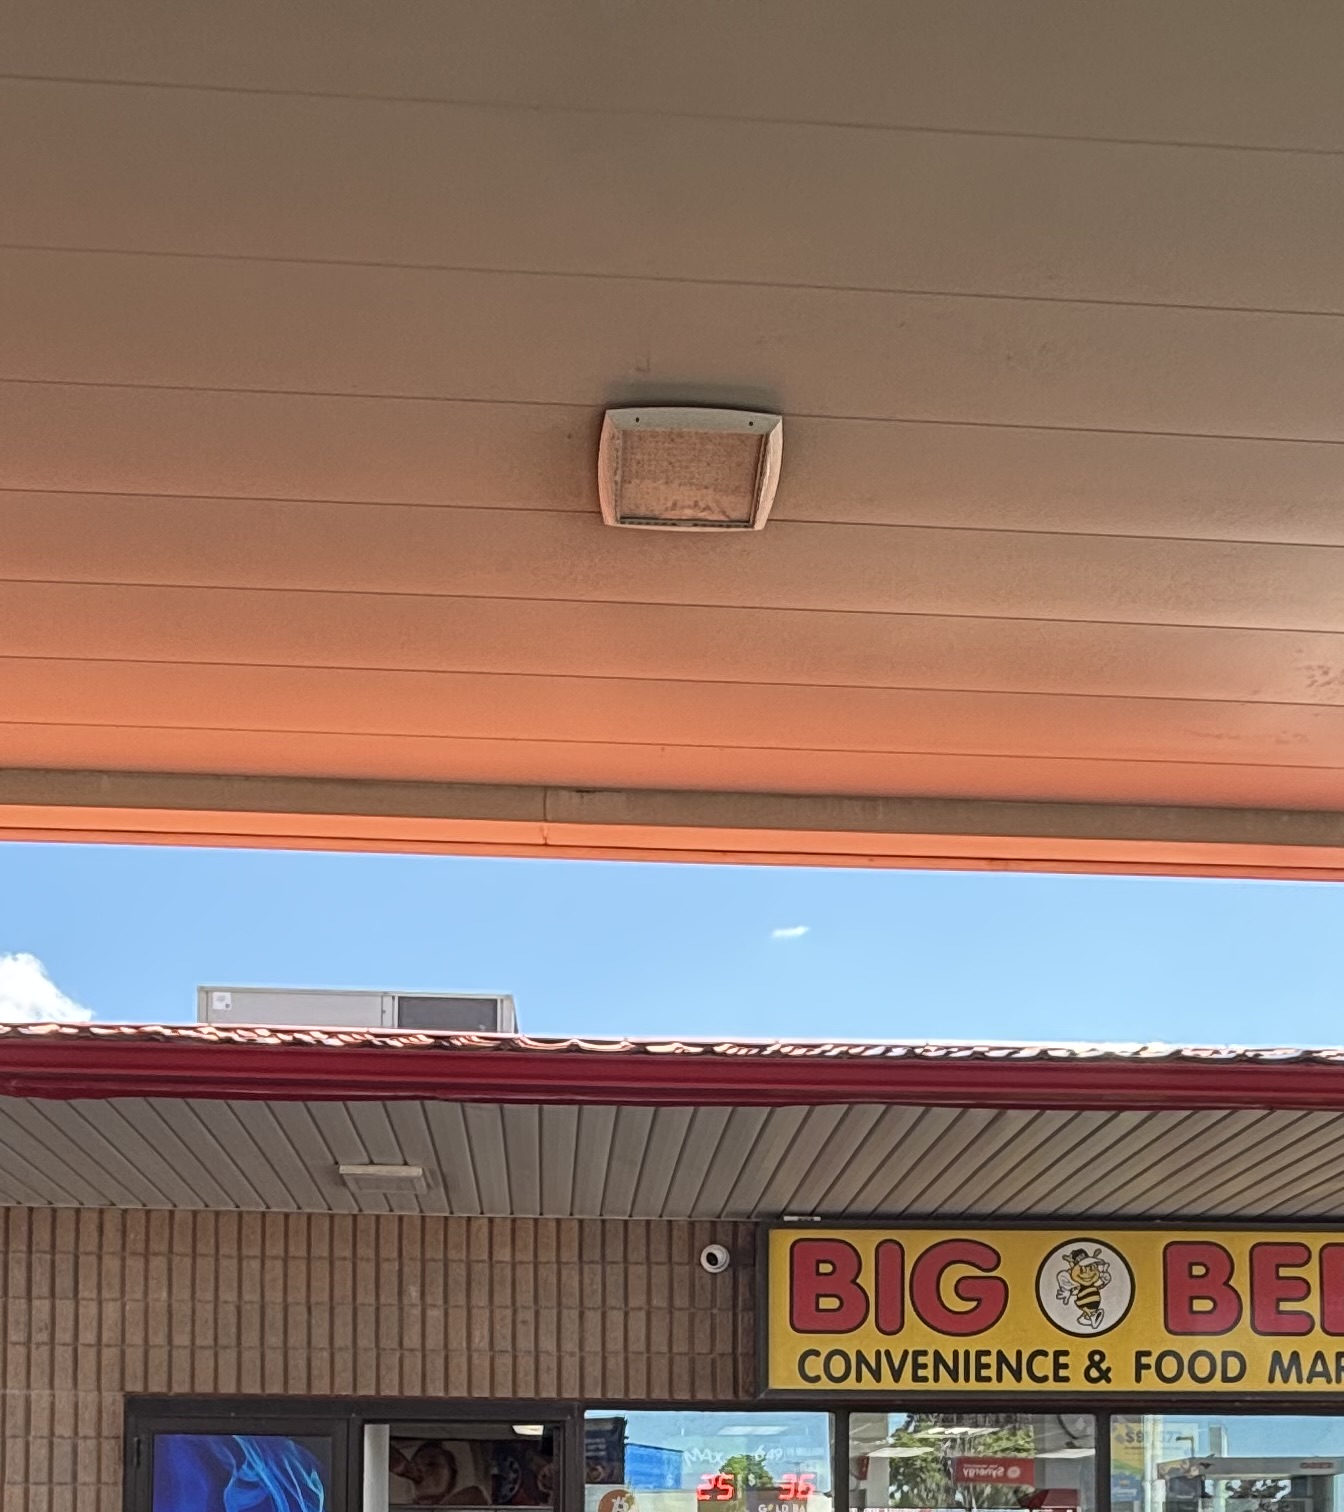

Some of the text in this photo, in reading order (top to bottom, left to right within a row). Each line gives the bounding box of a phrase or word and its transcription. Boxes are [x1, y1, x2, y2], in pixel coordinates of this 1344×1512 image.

[789, 1237, 1009, 1337] BIG
[798, 1348, 1070, 1384] CONVENIENCE
[1083, 1349, 1112, 1385] &
[1134, 1349, 1247, 1385] FOOD
[697, 1473, 735, 1500] 25
